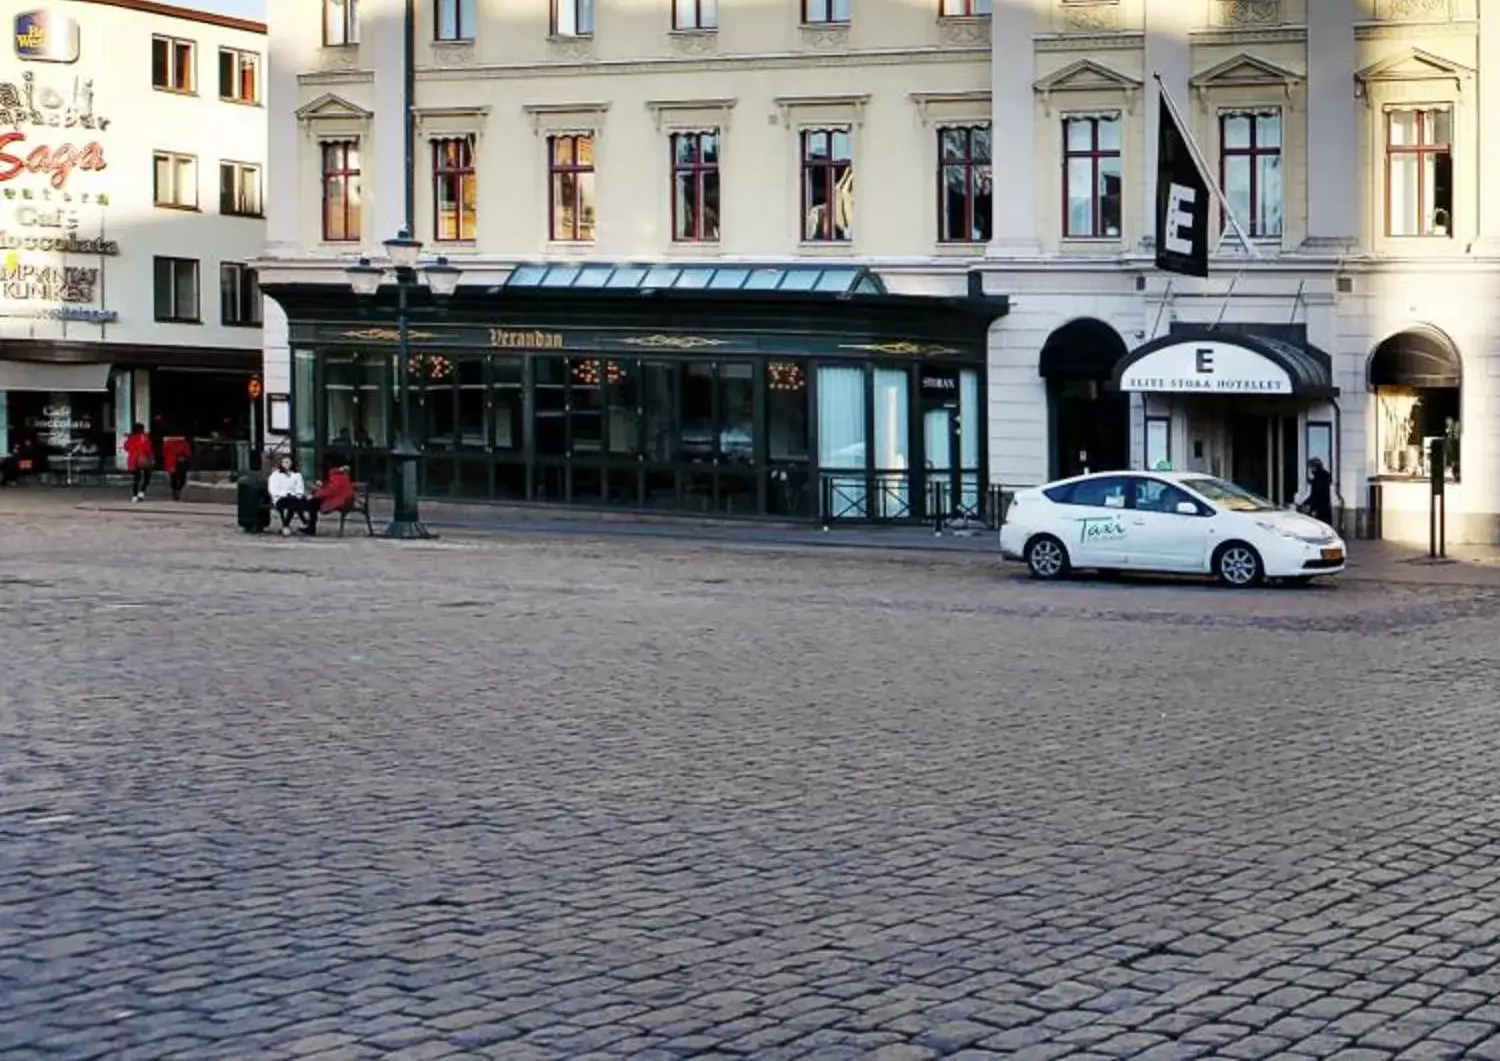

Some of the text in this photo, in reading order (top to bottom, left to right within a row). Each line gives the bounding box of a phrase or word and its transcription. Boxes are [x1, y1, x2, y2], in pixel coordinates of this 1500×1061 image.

[0, 132, 108, 190] Saga
[1165, 181, 1196, 255] E
[1195, 348, 1214, 374] E
[1130, 378, 1282, 390] ELITE STORA HOTELLET
